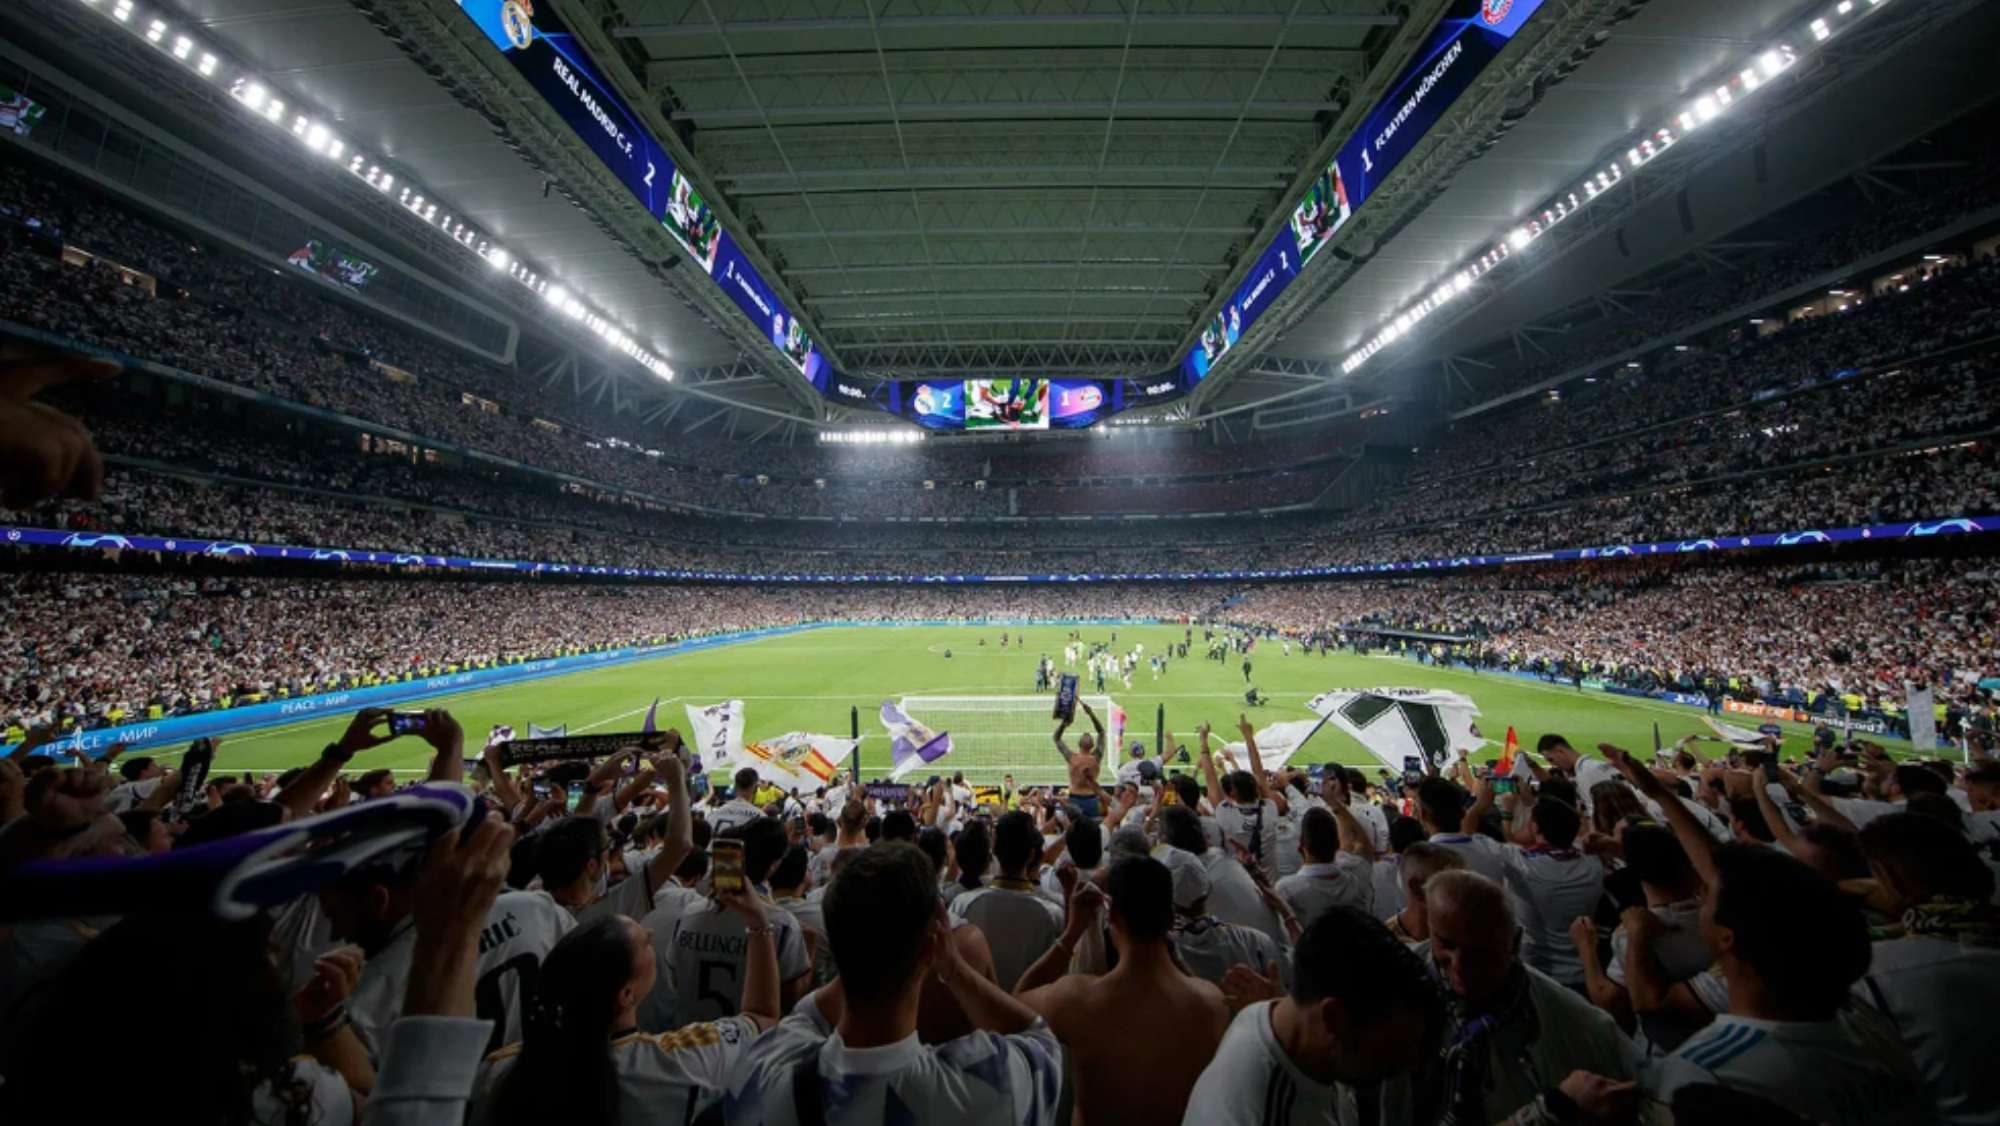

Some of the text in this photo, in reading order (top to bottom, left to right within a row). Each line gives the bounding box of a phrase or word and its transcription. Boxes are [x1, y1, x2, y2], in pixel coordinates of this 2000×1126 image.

[553, 56, 579, 96] REAL
[580, 89, 618, 137] MADRID
[1361, 148, 1373, 172] 1
[1384, 96, 1416, 139] BAYERN
[643, 161, 656, 187] 2
[942, 392, 952, 408] 2
[1061, 391, 1069, 406] 1
[281, 700, 316, 714] PEACE
[44, 735, 102, 756] PEACE
[119, 726, 158, 742] МИР
[679, 929, 747, 956] BELLINGH
[698, 960, 736, 1016] 5
